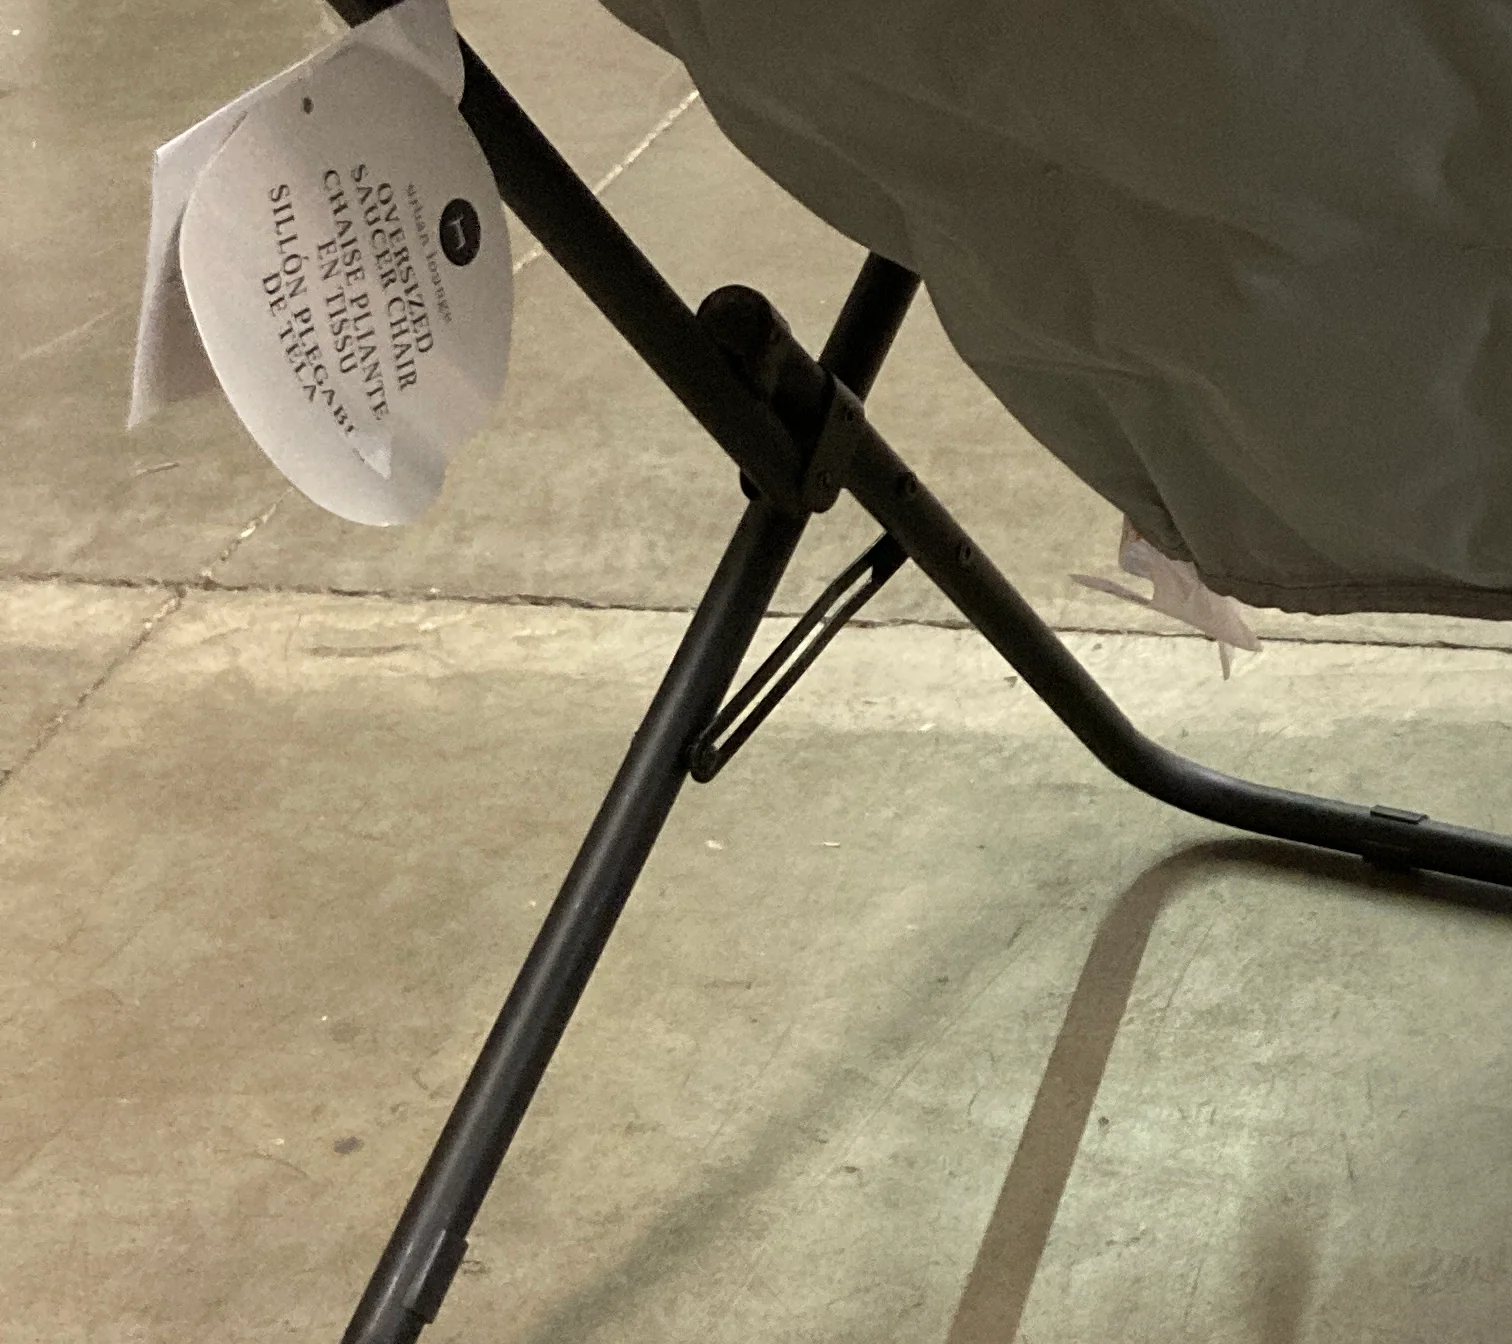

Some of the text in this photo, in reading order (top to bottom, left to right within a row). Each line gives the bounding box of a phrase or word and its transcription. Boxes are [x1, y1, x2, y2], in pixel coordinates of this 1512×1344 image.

[269, 183, 309, 299] SILLÓN
[316, 238, 359, 374] EN TISSU
[323, 169, 389, 421] CHAISE PLIANTE
[351, 163, 418, 391] SAUCER CHAIR
[377, 182, 434, 353] OVERSIZED
[262, 271, 317, 403] DE TELA
